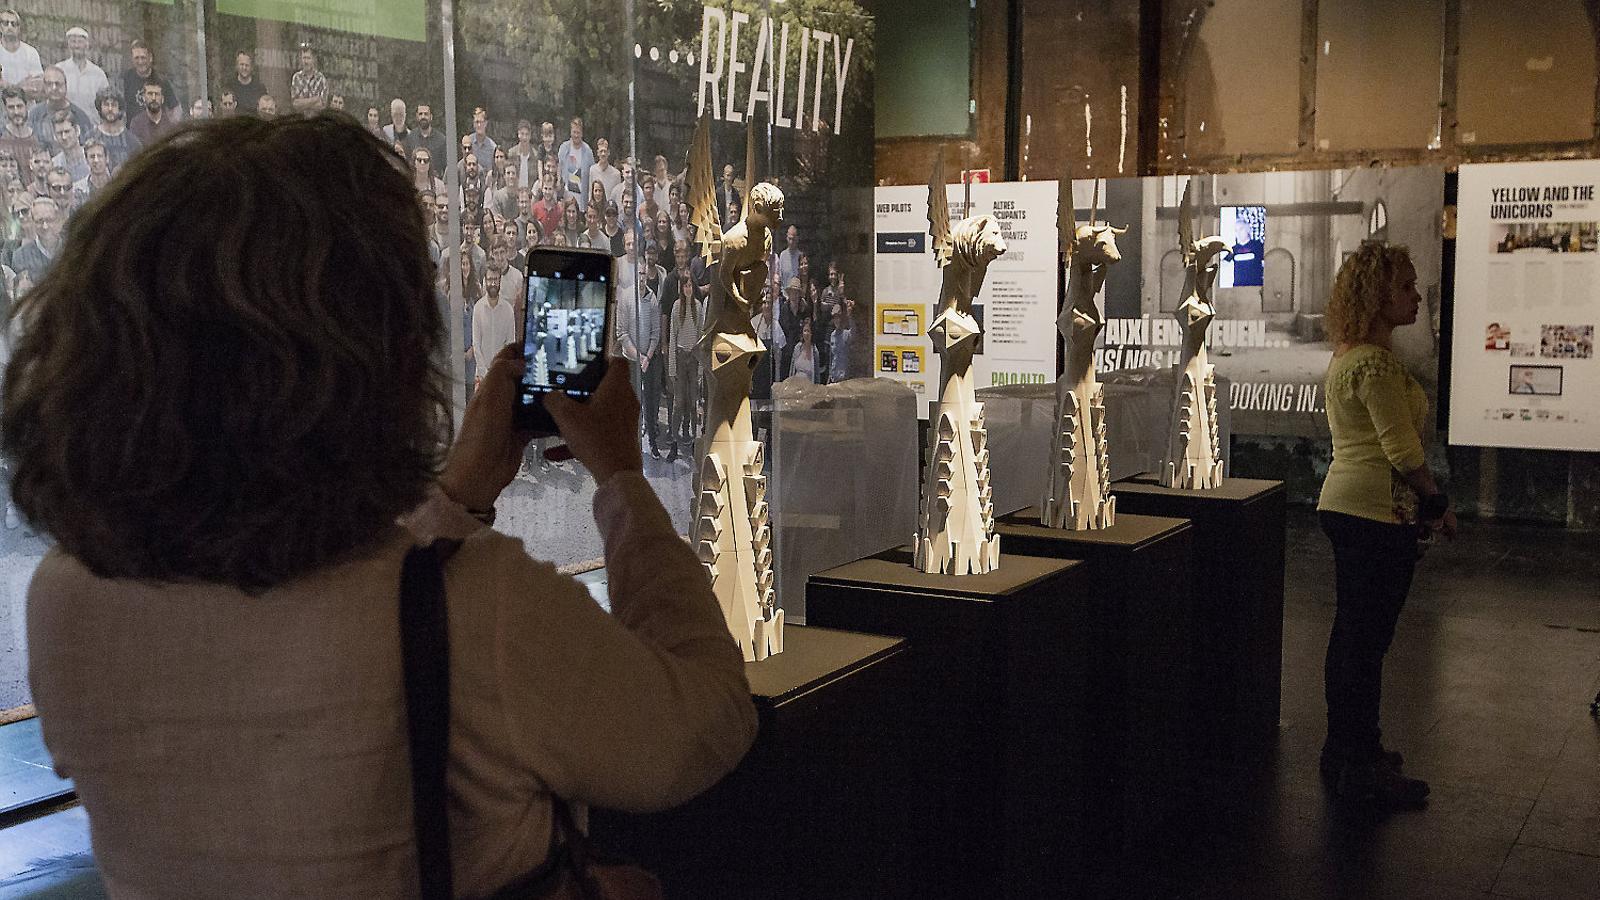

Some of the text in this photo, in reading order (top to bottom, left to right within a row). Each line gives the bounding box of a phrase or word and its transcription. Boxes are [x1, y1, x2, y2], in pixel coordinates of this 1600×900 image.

[1491, 185, 1595, 203] YELLOW AND THE
[876, 203, 912, 213] WEB PILOTS
[993, 201, 1015, 210] ALTRES
[1490, 203, 1553, 219] UNICORNS
[1105, 313, 1149, 345] AIXÍ
[1095, 344, 1125, 374] ASÍ
[1124, 349, 1164, 370] NOS
[991, 371, 1045, 385] PALO ALTO
[1229, 382, 1294, 412] OOKING
